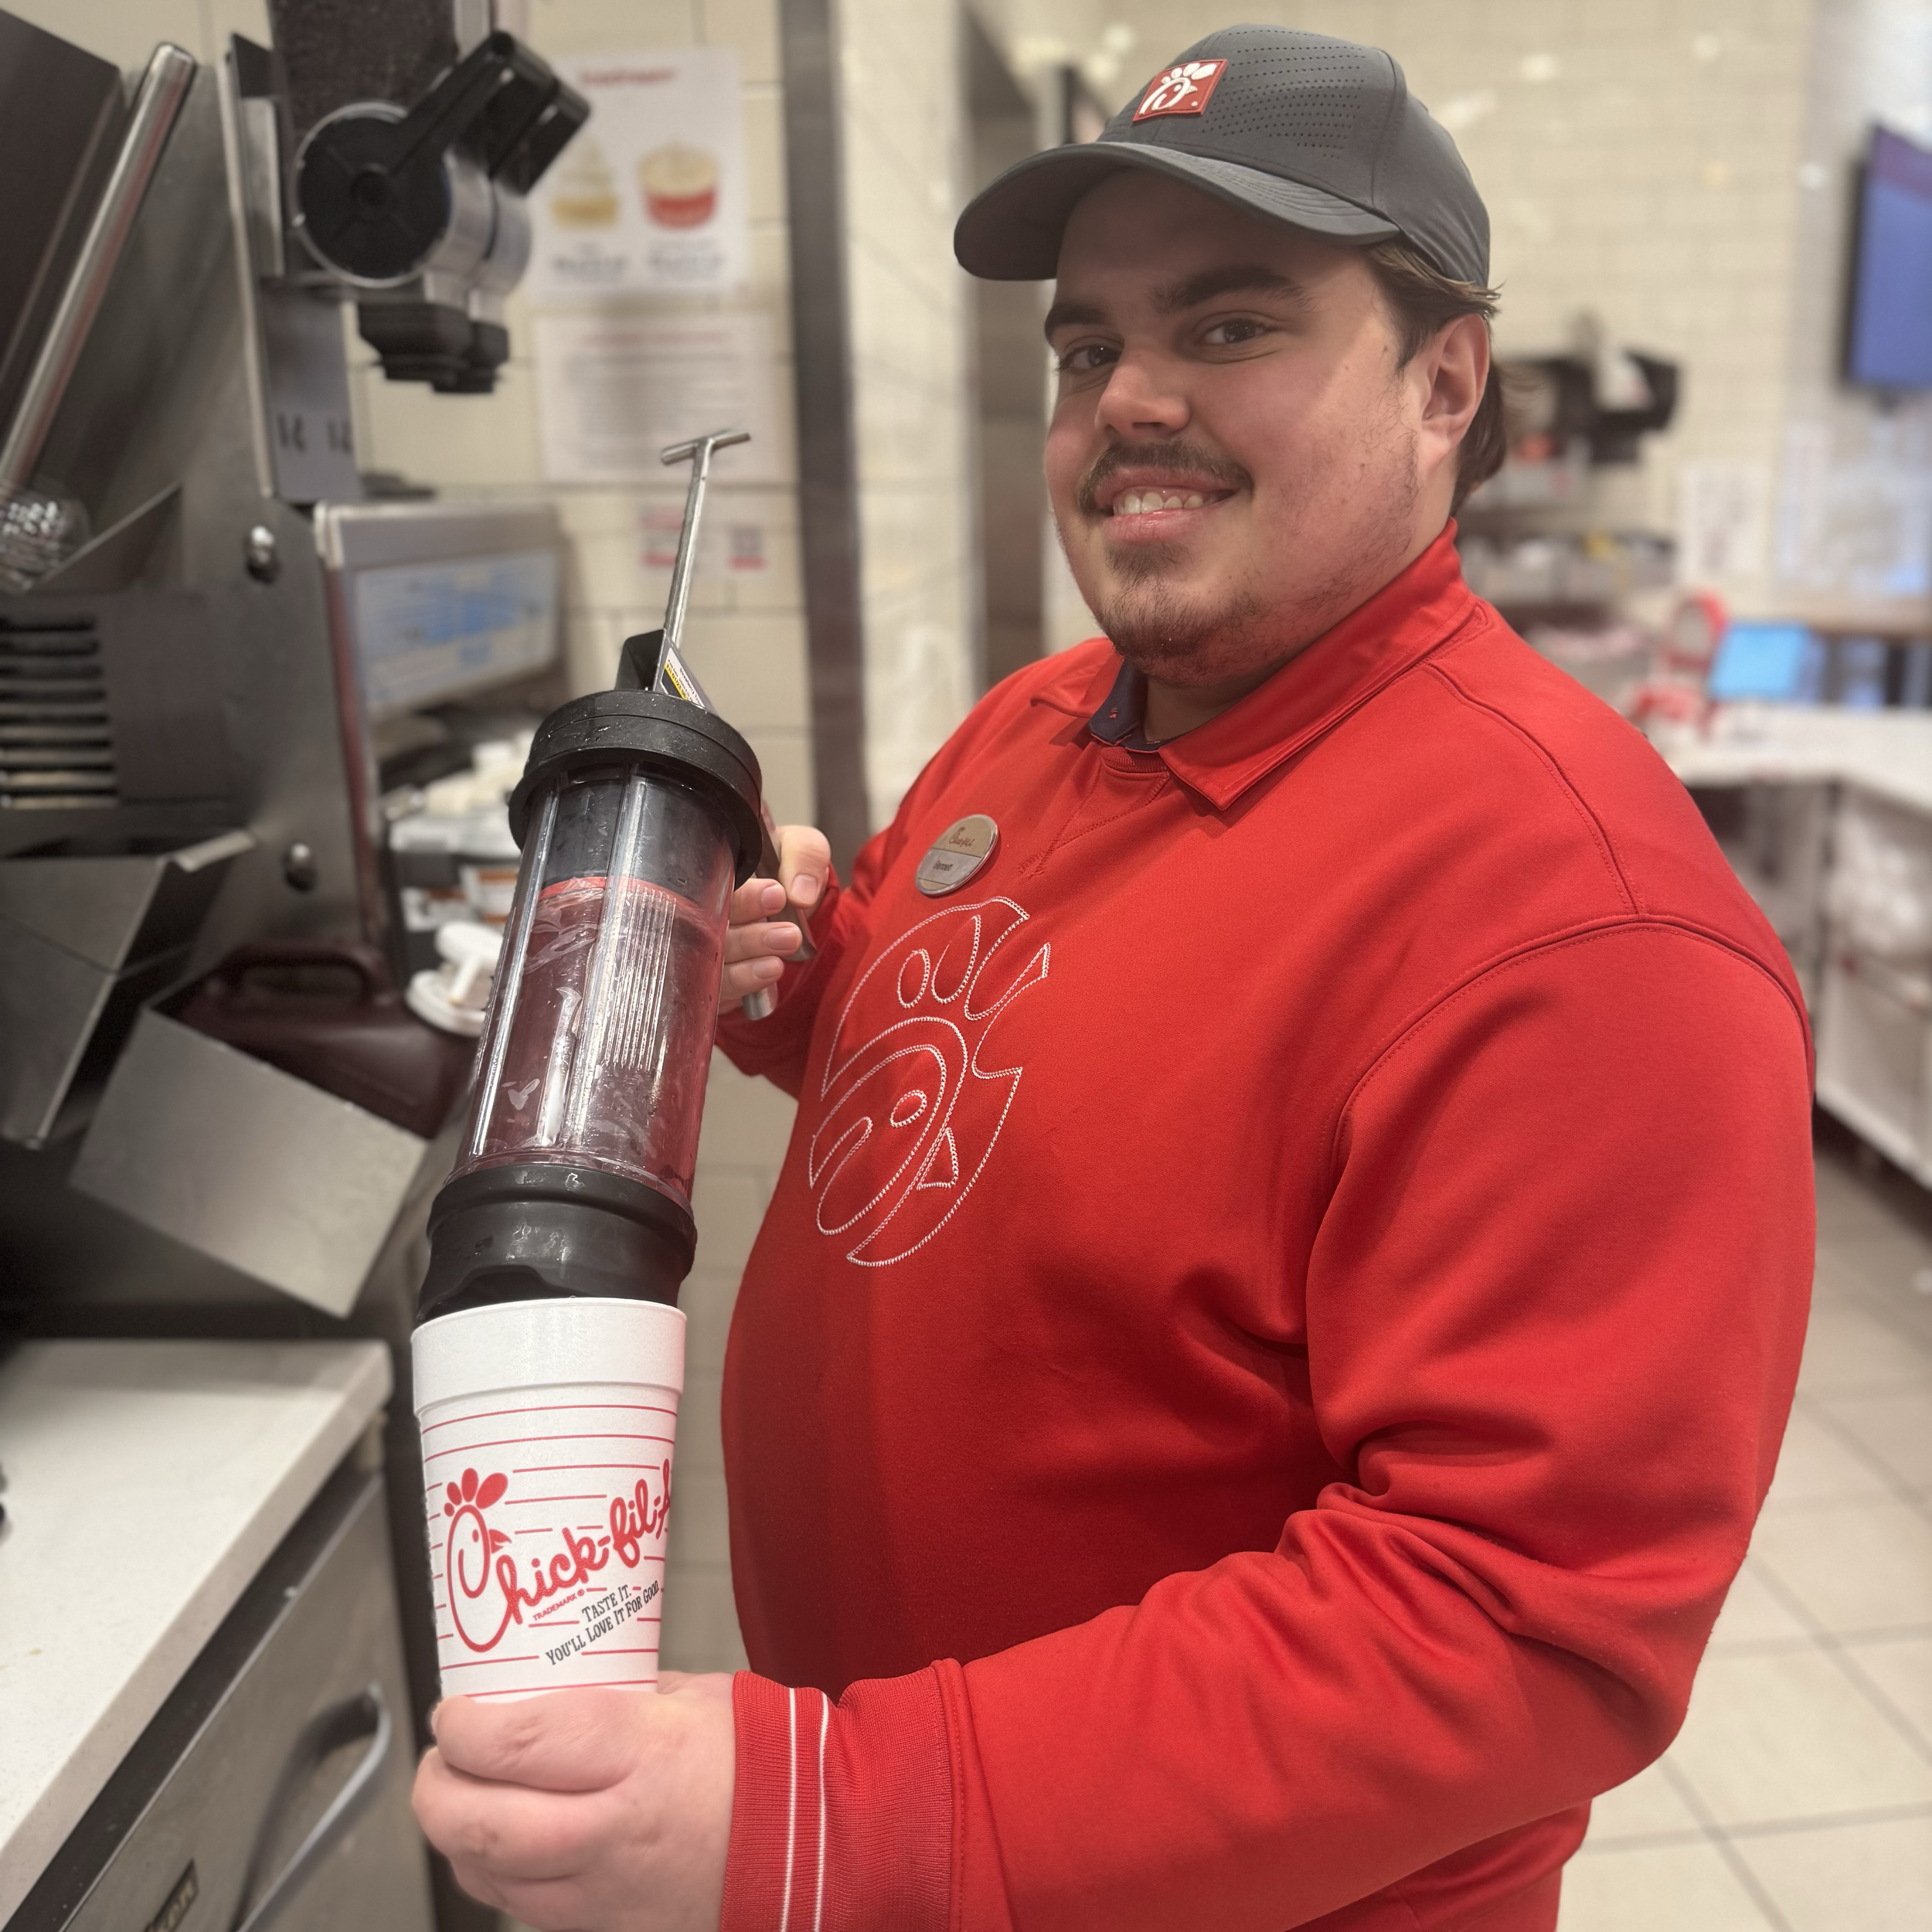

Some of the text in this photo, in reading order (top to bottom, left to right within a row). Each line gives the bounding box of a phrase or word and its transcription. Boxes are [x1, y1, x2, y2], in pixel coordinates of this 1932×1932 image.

[532, 1593, 577, 1621] TRADEMARK
[581, 1584, 632, 1623] TASTE IT.
[545, 1634, 587, 1665] YOU'LL
[585, 1616, 614, 1643] LOVE
[613, 1607, 625, 1625] IT
[624, 1596, 643, 1617] FOR
